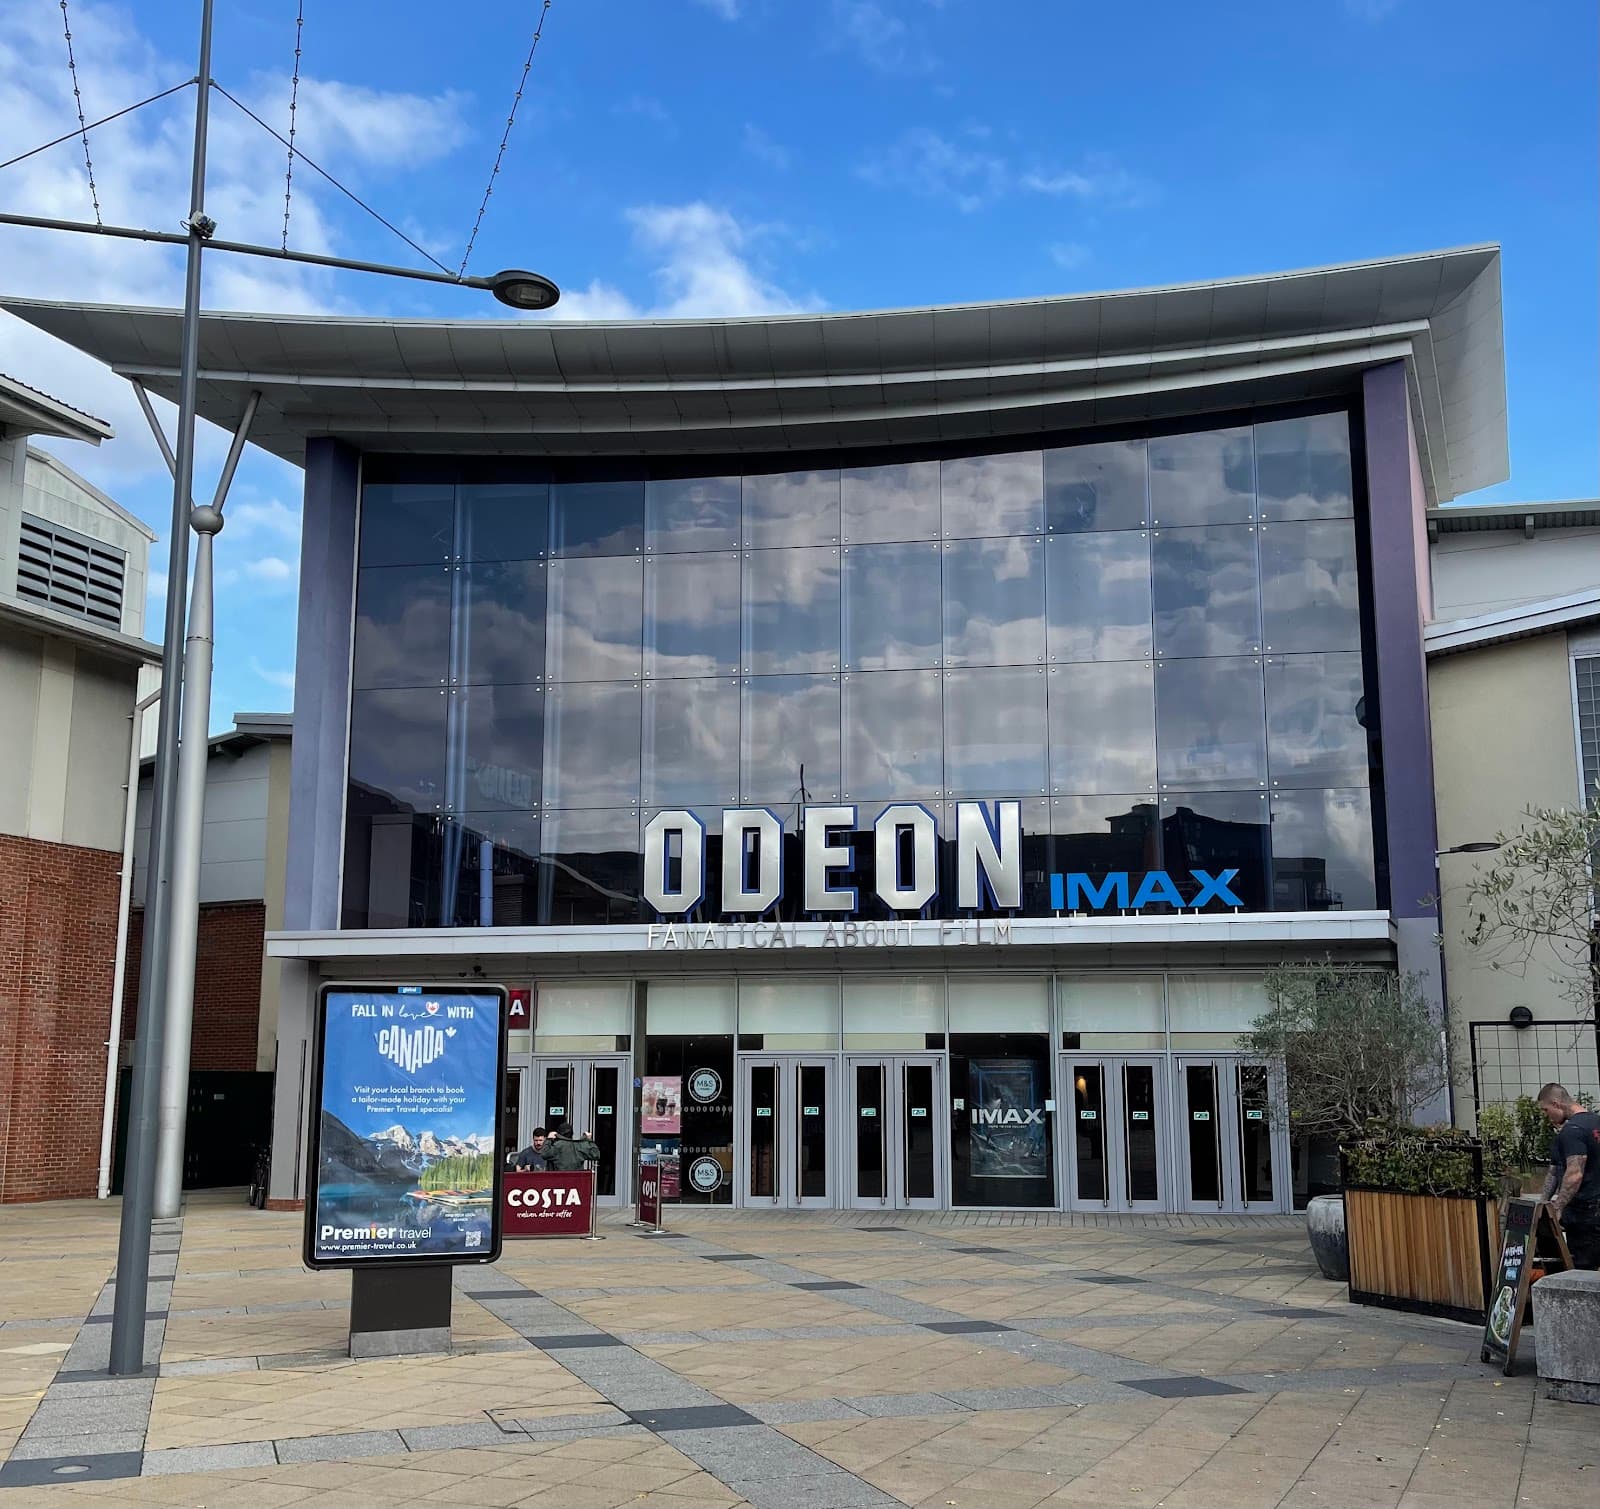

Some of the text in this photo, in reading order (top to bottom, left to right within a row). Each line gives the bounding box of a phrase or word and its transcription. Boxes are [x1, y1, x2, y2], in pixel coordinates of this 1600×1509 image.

[643, 801, 1022, 914] ODEON
[1050, 869, 1244, 909] IMAX
[648, 918, 1012, 949] FANATICAL ABOUT FILM
[352, 1003, 474, 1020] FALL IN love WITH
[378, 1025, 444, 1074] CANADA
[354, 1086, 464, 1095] Visit your local branch to book
[358, 1095, 402, 1103] tailor-made
[403, 1096, 430, 1105] holiday
[449, 1097, 466, 1105] your
[366, 1105, 453, 1114] Premier Travel specialist
[971, 1108, 1044, 1124] IMAX
[507, 1188, 582, 1209] COSTA
[320, 1222, 432, 1240] Premier travel
[320, 1241, 417, 1253] www.premier-travel.co.uk
